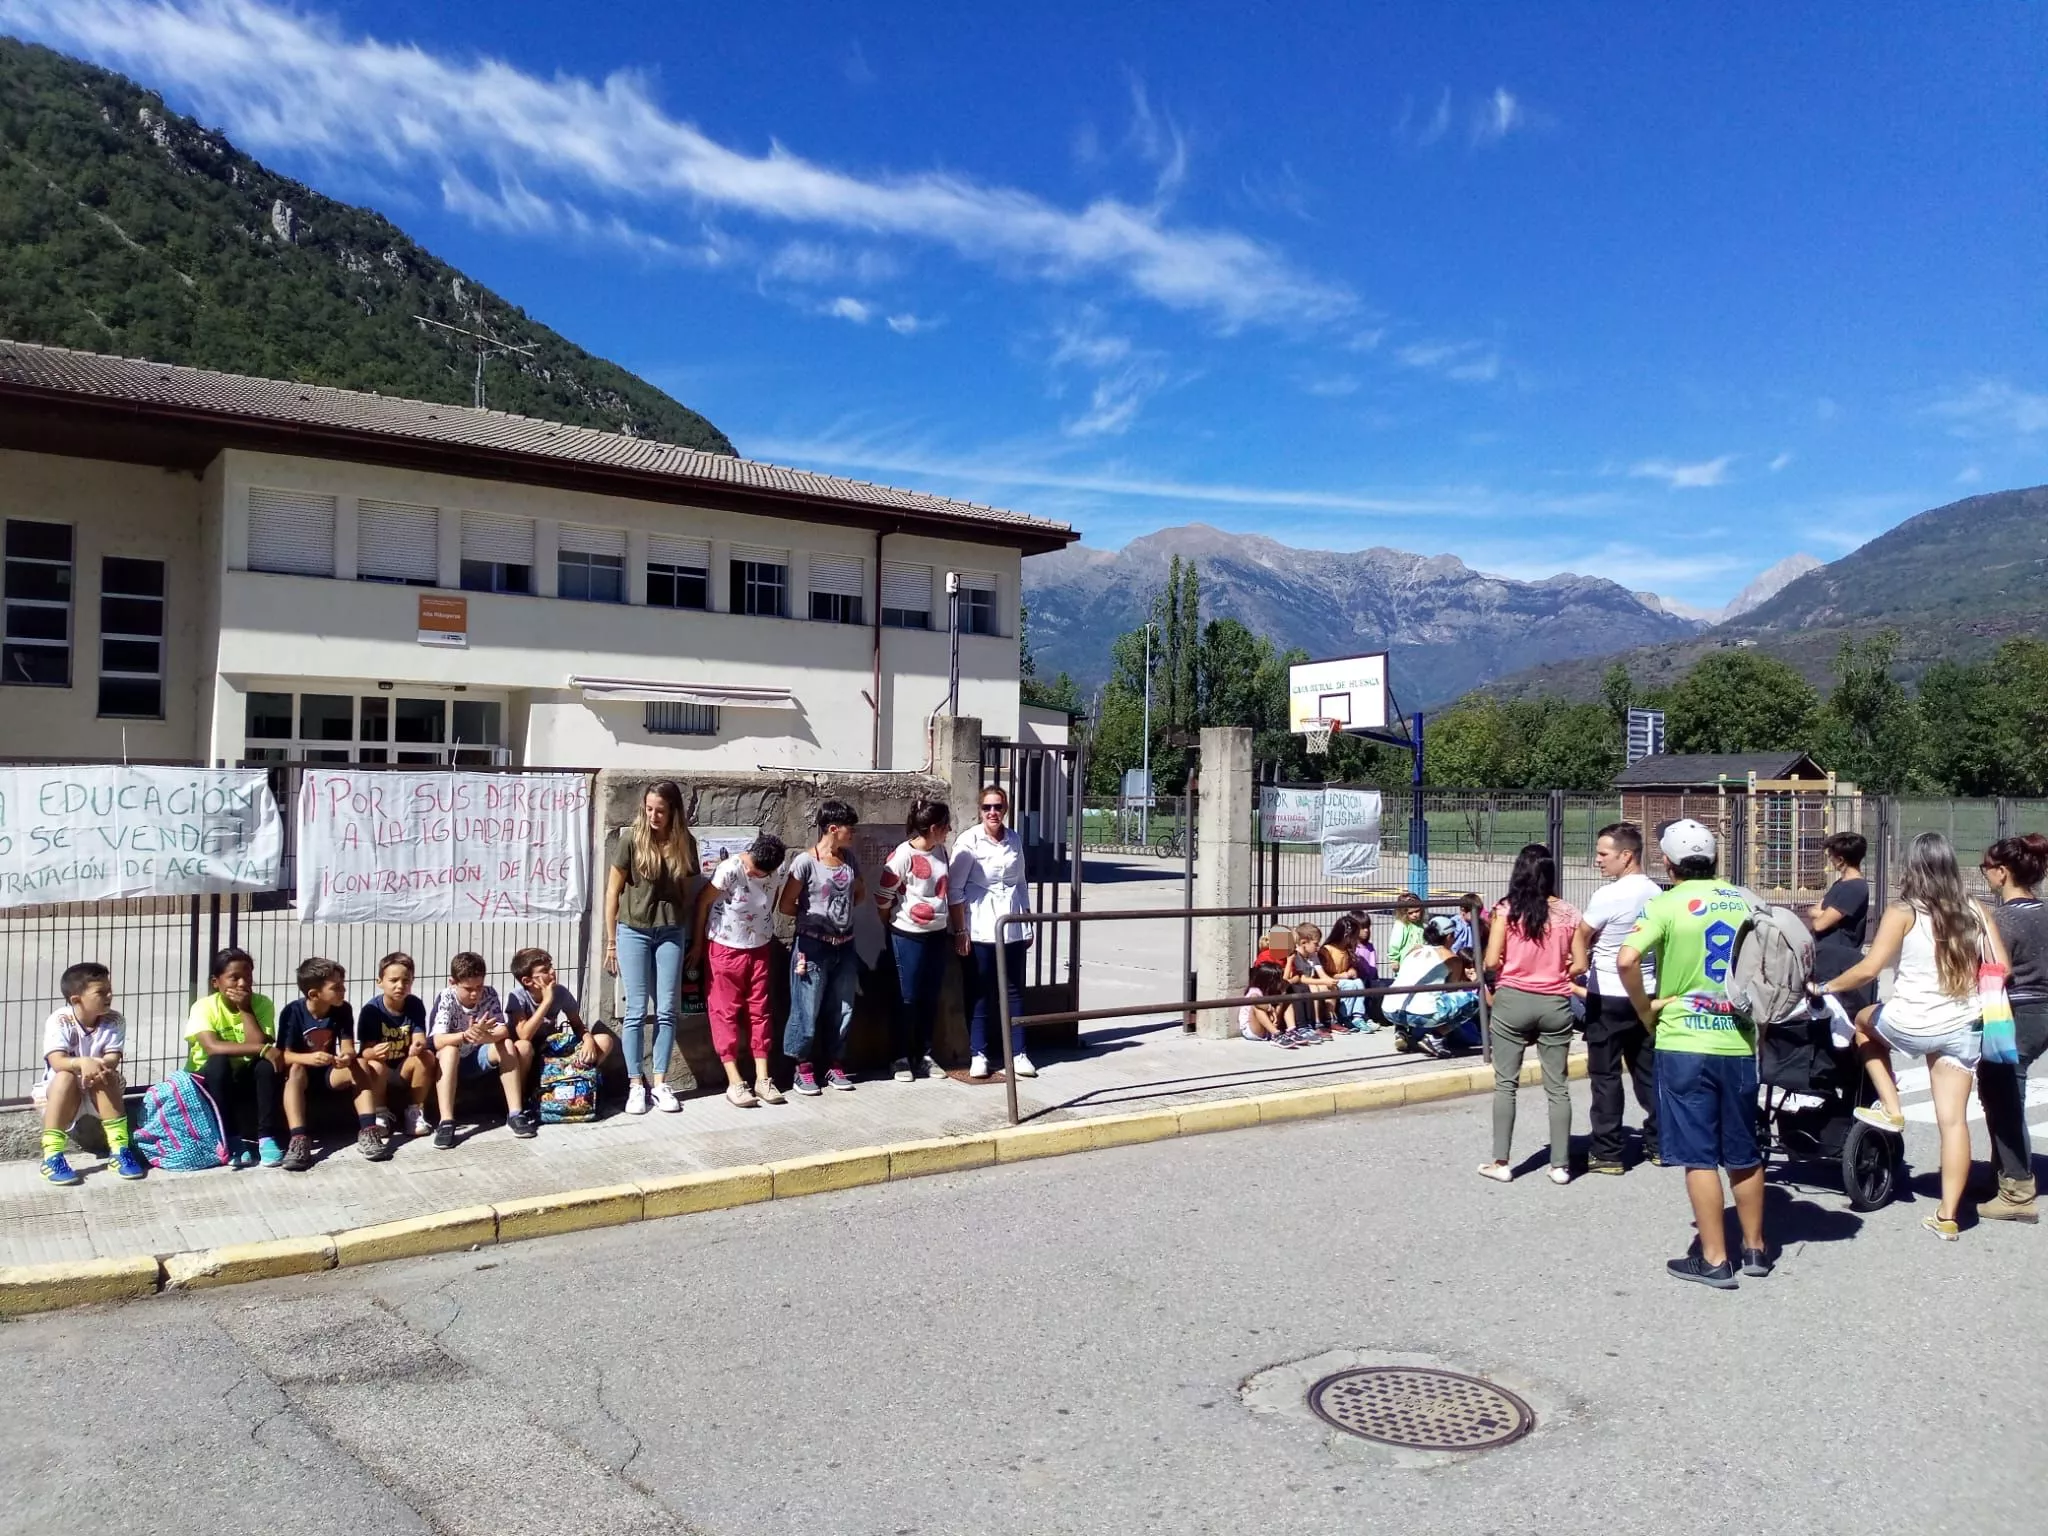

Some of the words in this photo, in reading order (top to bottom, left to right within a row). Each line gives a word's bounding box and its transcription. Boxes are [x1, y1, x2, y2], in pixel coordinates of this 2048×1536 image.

[40, 777, 253, 816] EDUCACIÓN
[411, 783, 471, 813] SUS
[487, 782, 587, 813] DERECHOS
[30, 826, 72, 856] SE
[98, 821, 243, 855] VENDE!
[342, 822, 358, 851] A
[377, 821, 404, 848] LA
[126, 858, 154, 878] DE
[223, 858, 270, 885] YA!
[499, 859, 521, 880] DE
[466, 889, 529, 920] YA!
[1710, 901, 1744, 912] pepsi
[1704, 920, 1737, 984] 8
